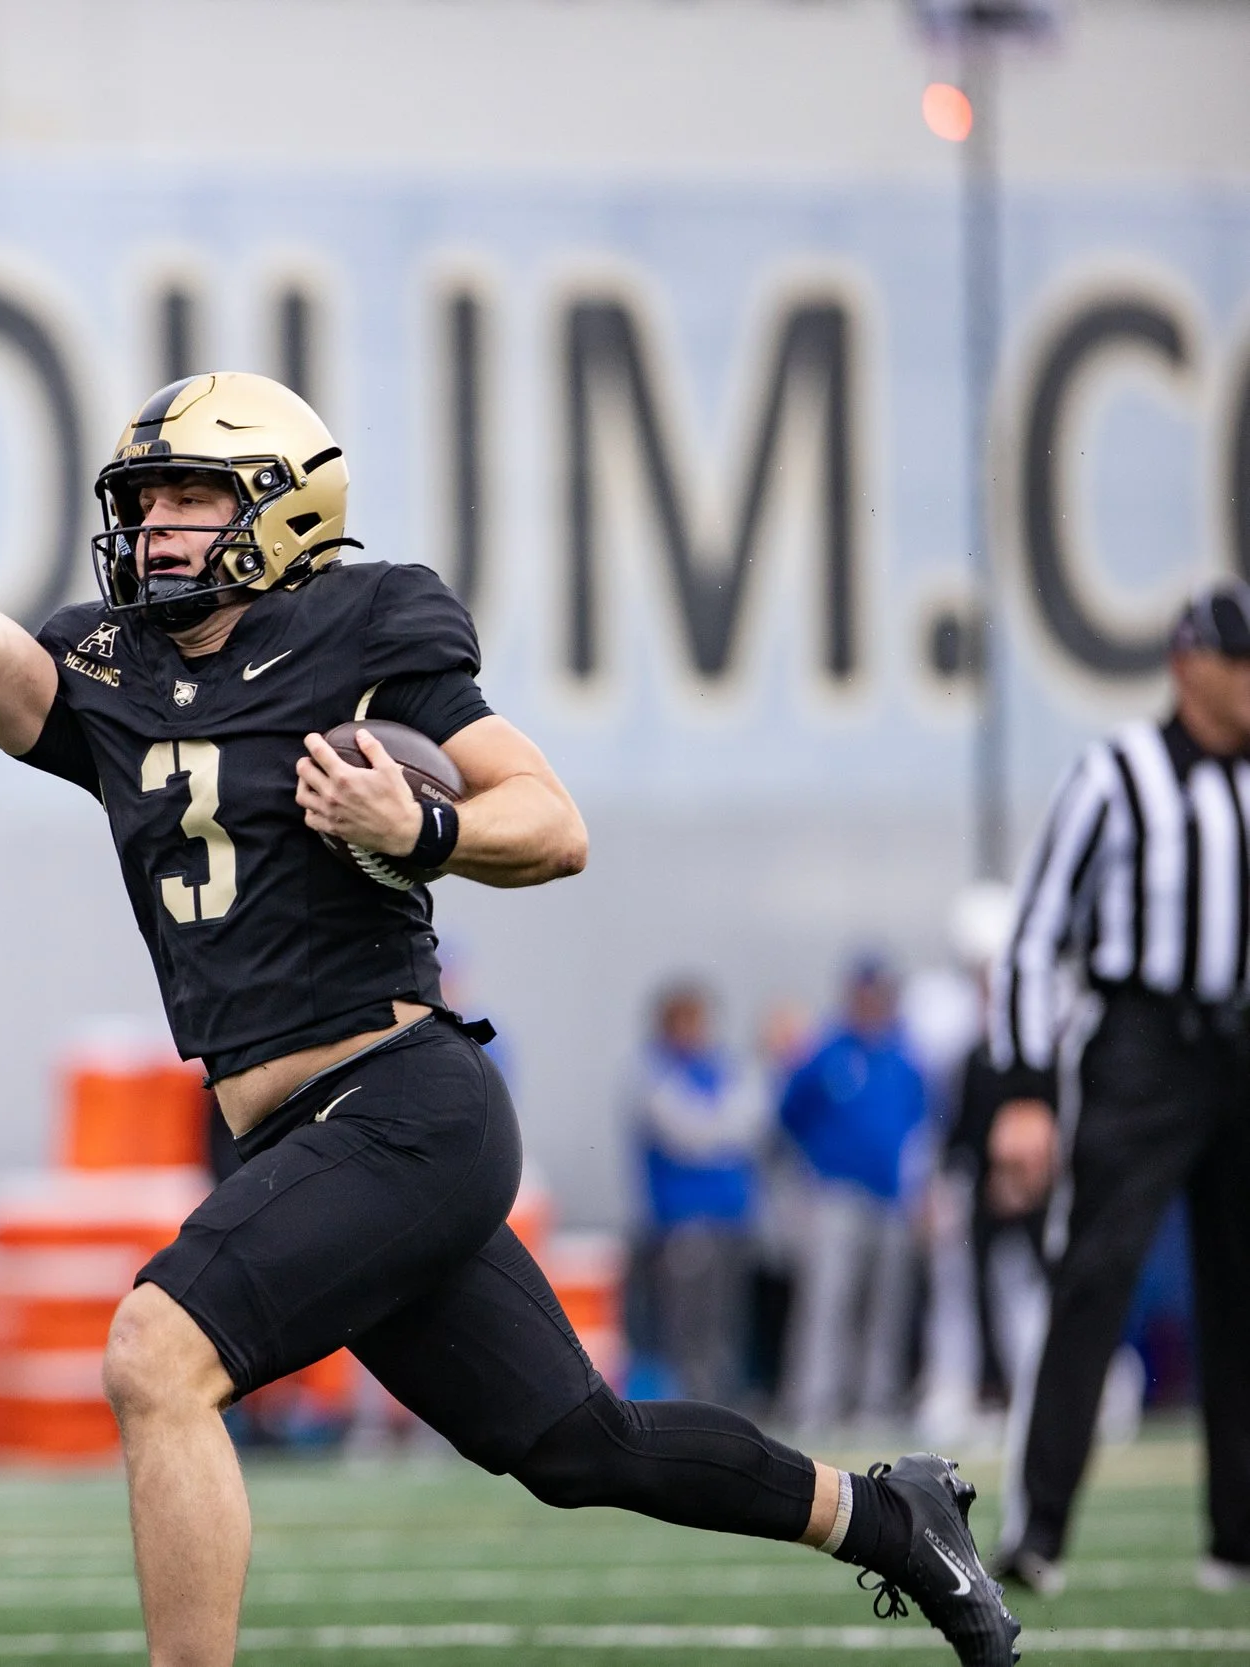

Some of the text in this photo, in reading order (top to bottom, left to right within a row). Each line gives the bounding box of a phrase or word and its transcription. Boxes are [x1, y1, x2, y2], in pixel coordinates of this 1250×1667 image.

[121, 442, 152, 459] ARMY
[62, 651, 122, 688] HELLUMS
[140, 738, 238, 924] 3
